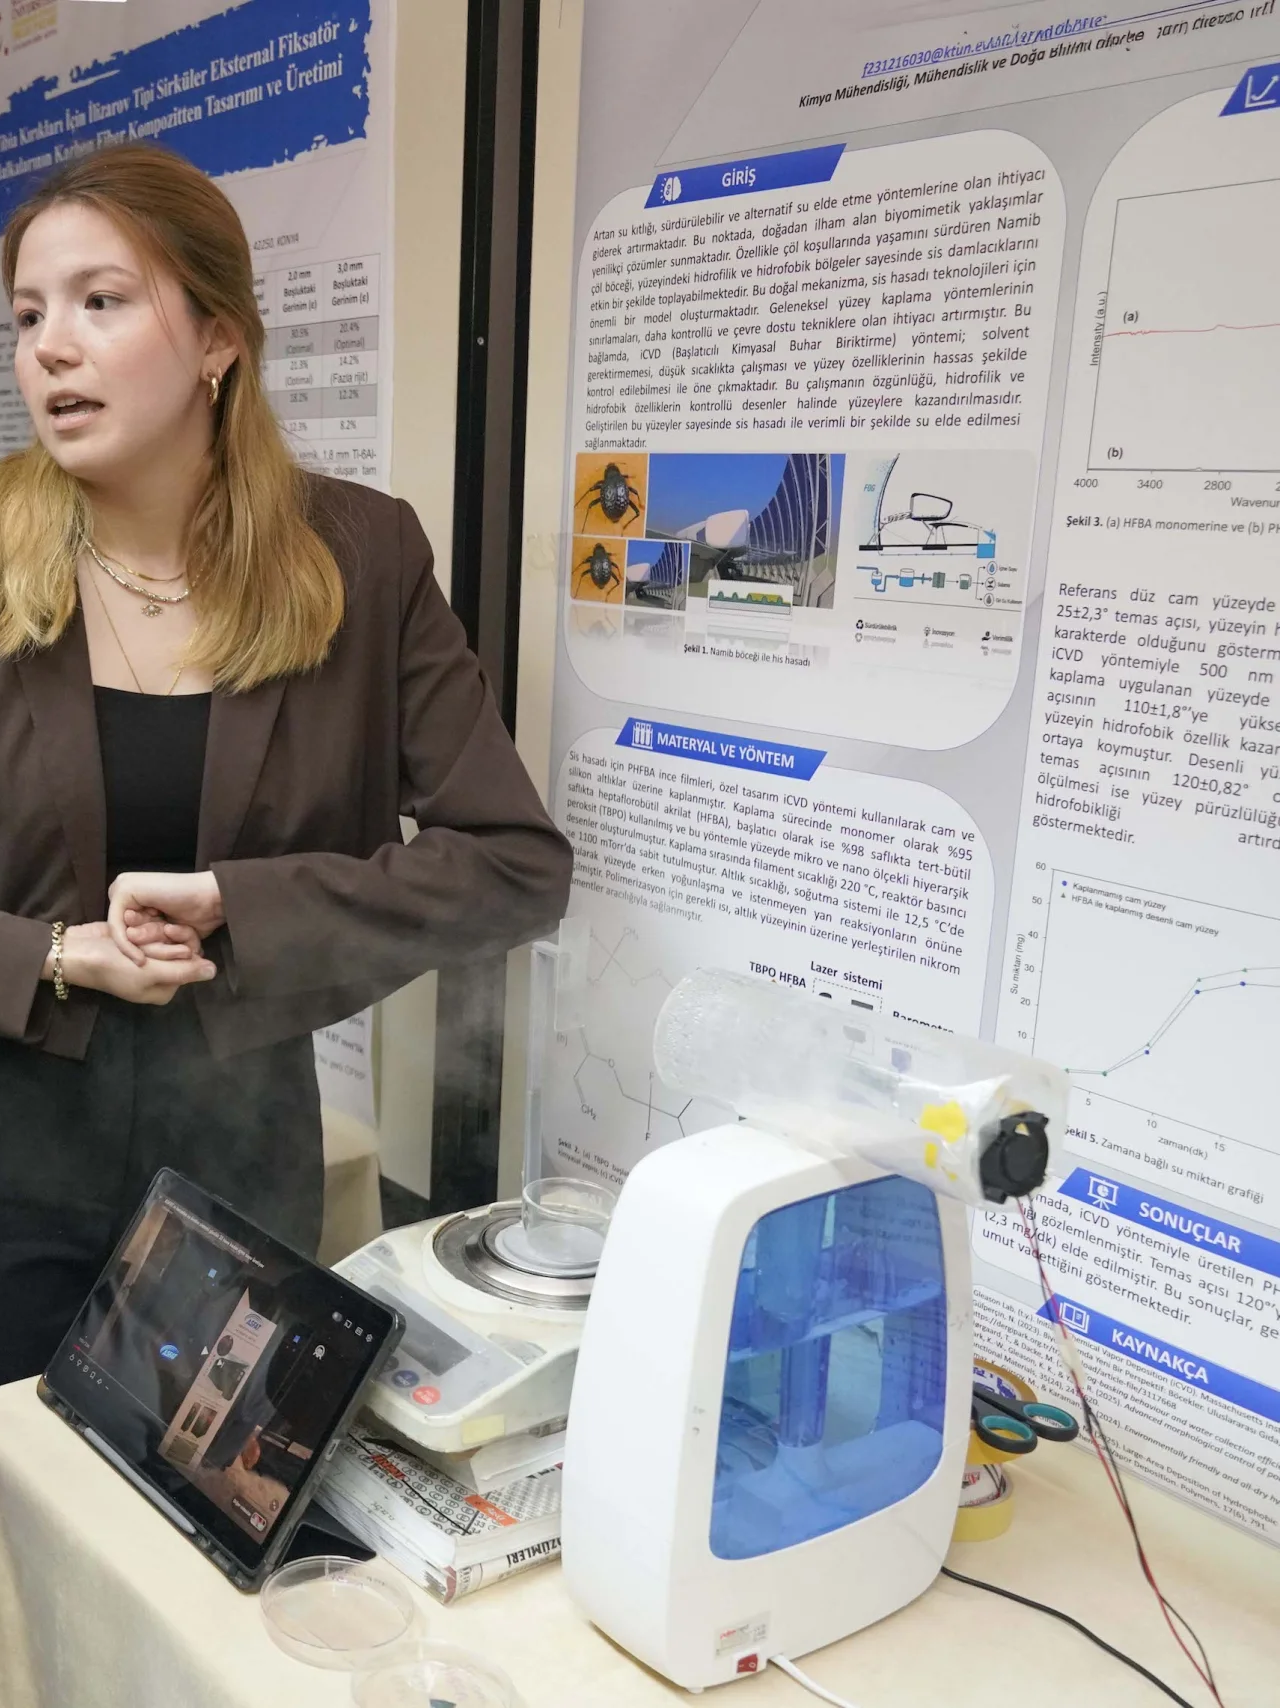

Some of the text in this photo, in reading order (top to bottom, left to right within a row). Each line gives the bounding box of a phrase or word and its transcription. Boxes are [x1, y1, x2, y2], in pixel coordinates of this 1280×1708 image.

[798, 48, 1046, 108] Kimya Mühendisliği, Mühendislik ve Doğa
[722, 166, 756, 187] GİRİŞ
[593, 170, 1045, 241] Artan su kıtlığı, sürdürülebilir ve alternatif su elde etme yöntemlerine olan ihtiyacı
[592, 191, 1044, 262] giderek artırmaktadır. Bu noktada, doğadan ilham alan biyomimetik yaklaşımlar
[592, 212, 1041, 279] yenilikçi çözümler sunmaktadır. Özellikle çöl koşullarında yaşamını sürdüren Namib
[284, 286, 316, 298] Boşluktaki
[333, 276, 368, 291] Boşluktaki
[1123, 311, 1138, 324] (a)
[1107, 448, 1124, 460] (b)
[1073, 478, 1098, 488] 4000
[1137, 480, 1164, 490] 3400
[1204, 480, 1232, 491] 2800
[1066, 515, 1264, 536] Şekil 3. (a) HFBA monomerine ve (b)
[1059, 583, 1276, 614] Referans düz cam yüzeyde
[1115, 610, 1158, 626] temas
[1165, 616, 1200, 632] açısı,
[1209, 618, 1266, 637] yüzeyin
[684, 644, 810, 666] Şekil 1. Namib böceği ile his hasadı
[657, 732, 794, 769] MATERYAL VE YÖNTEM
[567, 747, 975, 842] Sis hasadı için PHFBA ince filmleri, özel tasarım iCVD yöntemi kullanılarak cam ve
[1035, 862, 1046, 872] 60
[1032, 896, 1042, 906] 50
[1073, 883, 1166, 912] Kaplanmamış cam yüzey
[1028, 930, 1039, 940] 40
[750, 961, 776, 978] TBPO
[810, 960, 883, 990] Lazer sistemi
[1024, 964, 1034, 973] 30
[779, 971, 806, 988] HFBA
[1010, 983, 1018, 994] Su
[1020, 997, 1030, 1006] 20
[1017, 1030, 1027, 1040] 10
[1086, 1098, 1092, 1106] 5
[1146, 1119, 1158, 1129] 10
[1158, 1136, 1208, 1160] zaman(dk)
[1214, 1141, 1226, 1152] 15
[1090, 1134, 1098, 1144] 5.
[1101, 1138, 1141, 1160] Zamana
[1144, 1152, 1169, 1170] bağlı
[1172, 1165, 1184, 1175] su
[1186, 1170, 1225, 1190] miktarı
[1227, 1185, 1264, 1204] grafiği
[1139, 1202, 1241, 1254] SONUÇLAR
[1080, 1210, 1254, 1286] iCVD yöntemiyle üretilen
[1112, 1328, 1208, 1384] KAYNAKÇA
